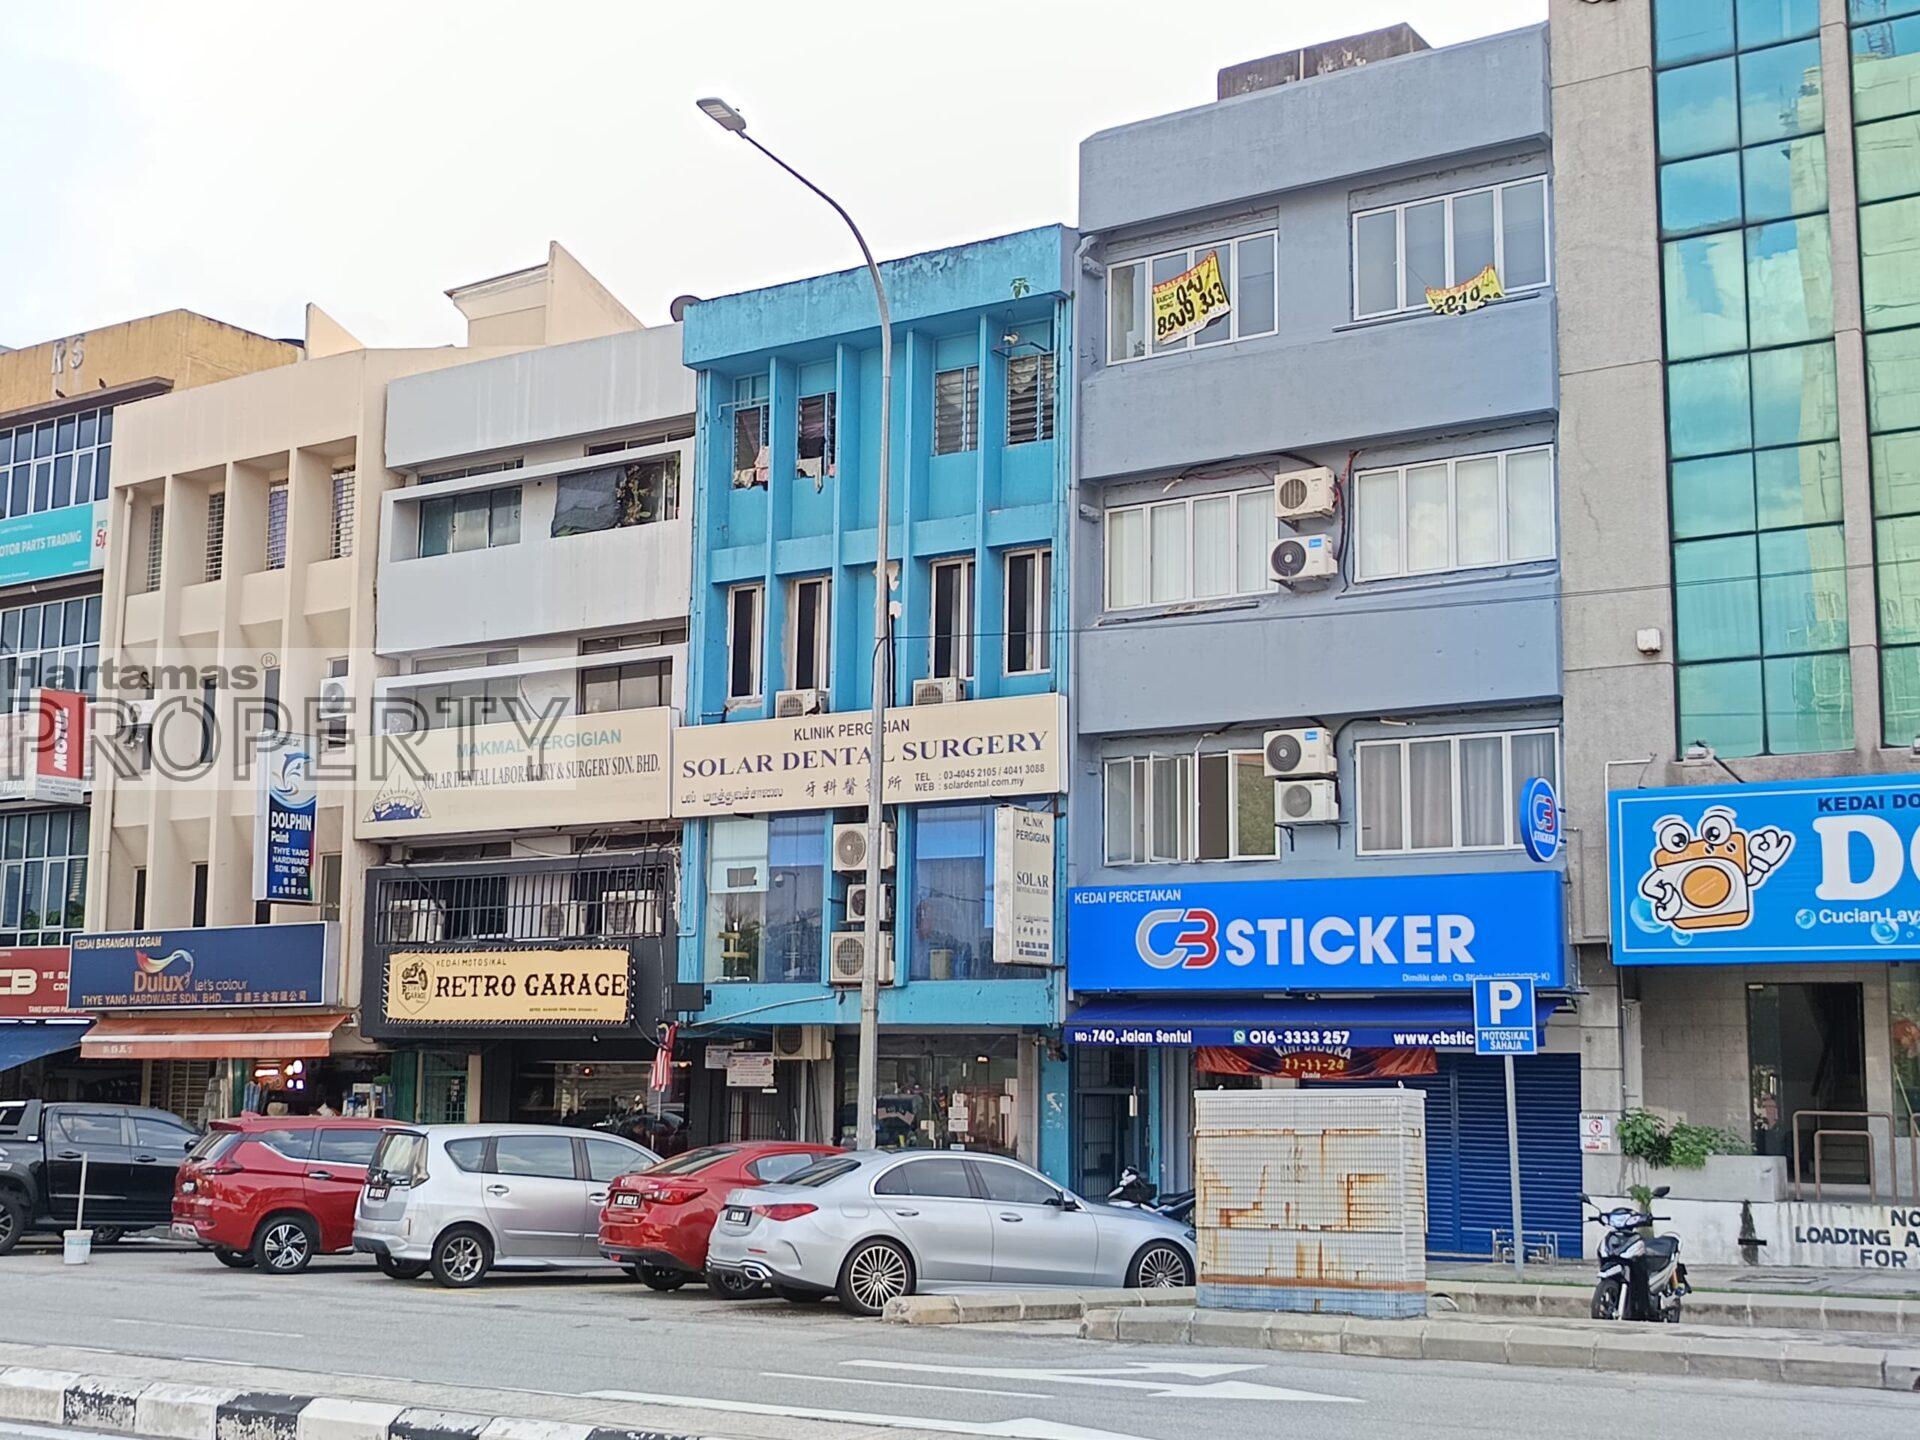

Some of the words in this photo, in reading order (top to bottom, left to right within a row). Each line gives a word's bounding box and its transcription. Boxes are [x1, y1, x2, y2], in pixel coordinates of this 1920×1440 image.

[21, 536, 46, 553] PARTS
[46, 530, 82, 549] TRADING
[53, 707, 70, 772] MOTUL
[794, 725, 834, 741] KLINIK
[456, 739, 526, 759] MAKMAL
[530, 729, 622, 751] PERGIGIAN
[682, 754, 778, 778] SOLAR
[902, 731, 1048, 761] SURGERY
[422, 770, 452, 791] SOLAR
[453, 767, 490, 787] DENTAL
[492, 761, 557, 784] LABORATORY
[557, 763, 565, 778] &
[566, 757, 611, 779] SURGERY
[611, 755, 635, 776] SDN.
[636, 754, 660, 773] BHD.
[915, 773, 931, 781] TEL
[943, 768, 975, 779] 03-4045
[977, 766, 997, 777] 2105
[1003, 765, 1023, 775] 4041
[914, 782, 935, 792] WEB
[943, 778, 1024, 791] solardental.com.my
[1817, 794, 1884, 812] KEDAI
[271, 811, 312, 832] DOLPHIN
[271, 830, 289, 843] Paint
[1016, 829, 1050, 844] PERGIGIAN
[272, 856, 309, 866] HARDWARE
[1812, 814, 1920, 900] D
[1016, 871, 1049, 888] SOLAR
[1074, 891, 1107, 904] KEDAI
[1108, 889, 1181, 903] PERCETAKAN
[1819, 907, 1881, 924] Cucian
[1885, 907, 1920, 926] Lay
[95, 937, 134, 949] BARANGAN
[135, 935, 162, 948] LOGAM
[1225, 914, 1476, 965] STICKER
[436, 959, 460, 967] KEDAI
[462, 958, 506, 967] MOTOSIKAL
[134, 970, 185, 992] Dulux
[435, 974, 516, 997] RETRO
[524, 973, 626, 997] GARAGE
[82, 995, 103, 1005] THYE
[104, 994, 127, 1005] YANG
[129, 993, 177, 1004] HARDWARE
[1489, 981, 1522, 1025] P
[1156, 1030, 1192, 1043] Sentul
[1250, 1030, 1319, 1044] 016-3333
[1323, 1030, 1350, 1044] 257
[1482, 1031, 1529, 1041] MOTOSIKAL
[1490, 1040, 1522, 1050] SAHAJA
[1285, 1058, 1344, 1071] 11-11-24
[1795, 1226, 1891, 1246] LOADING
[1860, 1249, 1908, 1268] FOR
